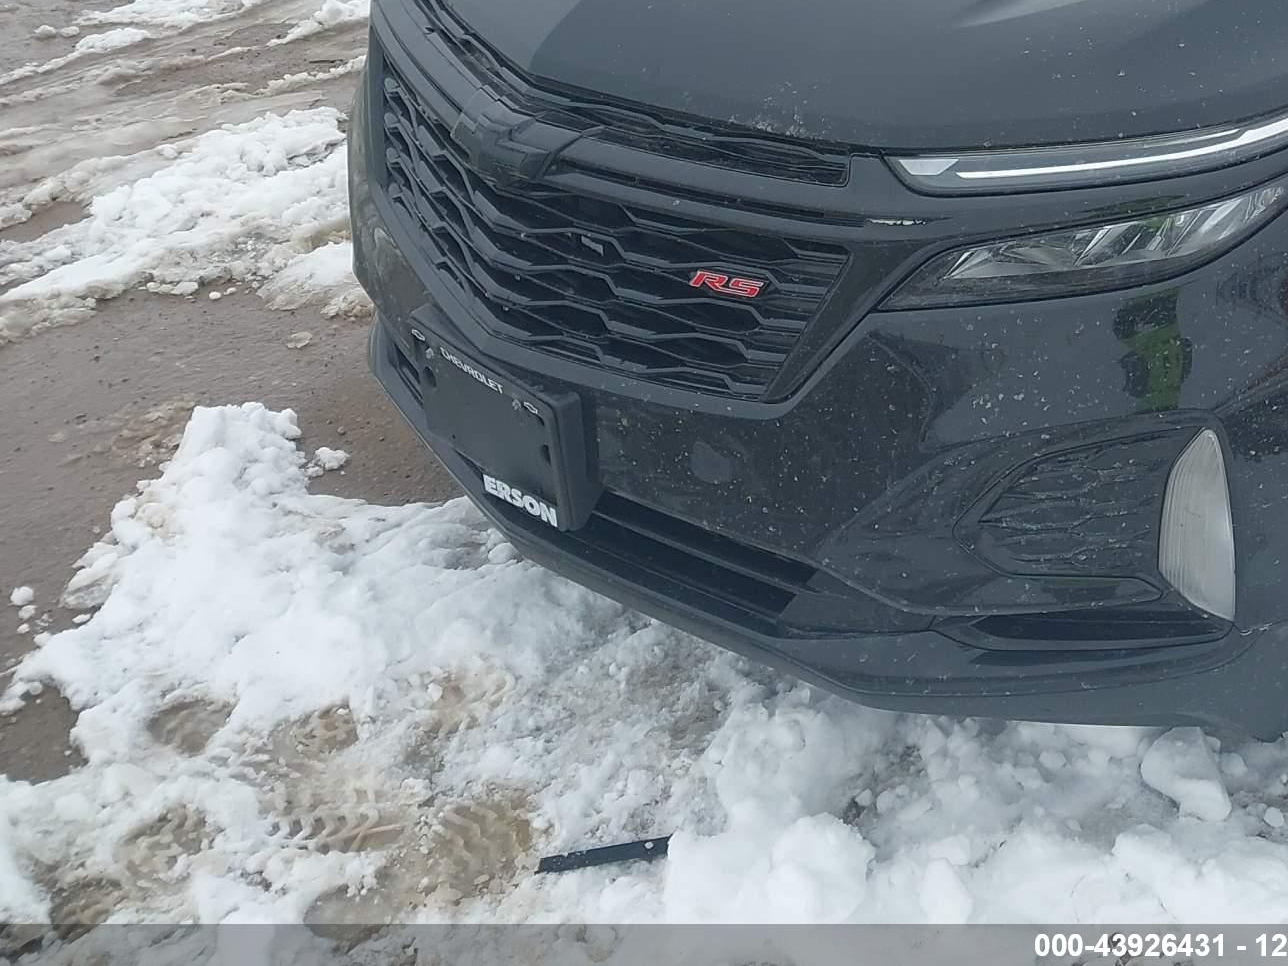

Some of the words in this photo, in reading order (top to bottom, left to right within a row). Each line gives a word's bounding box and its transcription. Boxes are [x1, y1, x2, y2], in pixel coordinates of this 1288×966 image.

[689, 270, 764, 298] RS
[440, 347, 504, 394] CHEVROLET
[483, 474, 558, 527] ERSON
